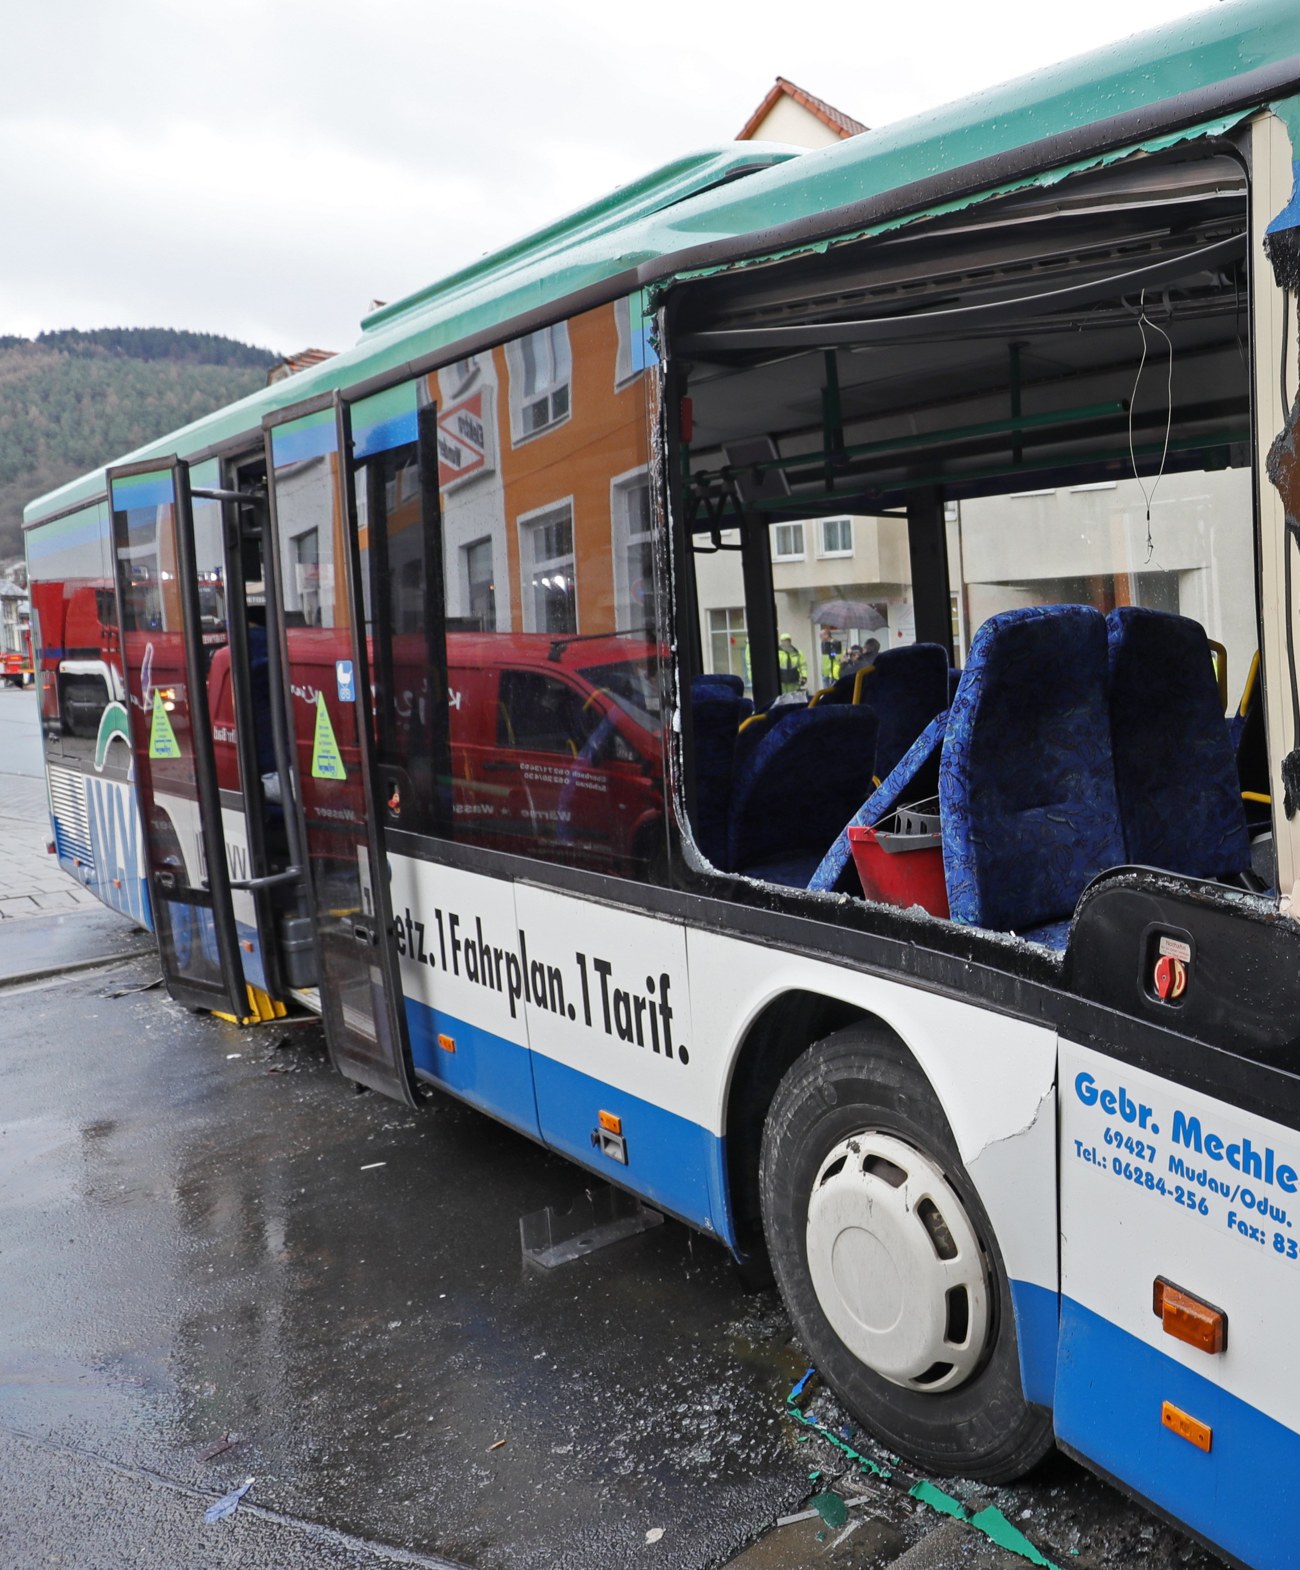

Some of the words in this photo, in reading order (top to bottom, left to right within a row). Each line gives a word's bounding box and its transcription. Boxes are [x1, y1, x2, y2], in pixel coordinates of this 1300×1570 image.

[395, 908, 436, 967] etz.
[435, 908, 447, 972] 1
[449, 913, 576, 1020] Fahrplan.
[576, 952, 592, 1027] 1
[594, 957, 689, 1065] Tarif.
[1074, 1072, 1159, 1135] Gebr.
[1074, 1140, 1107, 1169] Tel.:
[1113, 1158, 1209, 1216] 06284-256
[1227, 1211, 1265, 1245] Fax:
[1104, 1127, 1157, 1163] 69427
[1169, 1155, 1292, 1228] Mudau/Odw.
